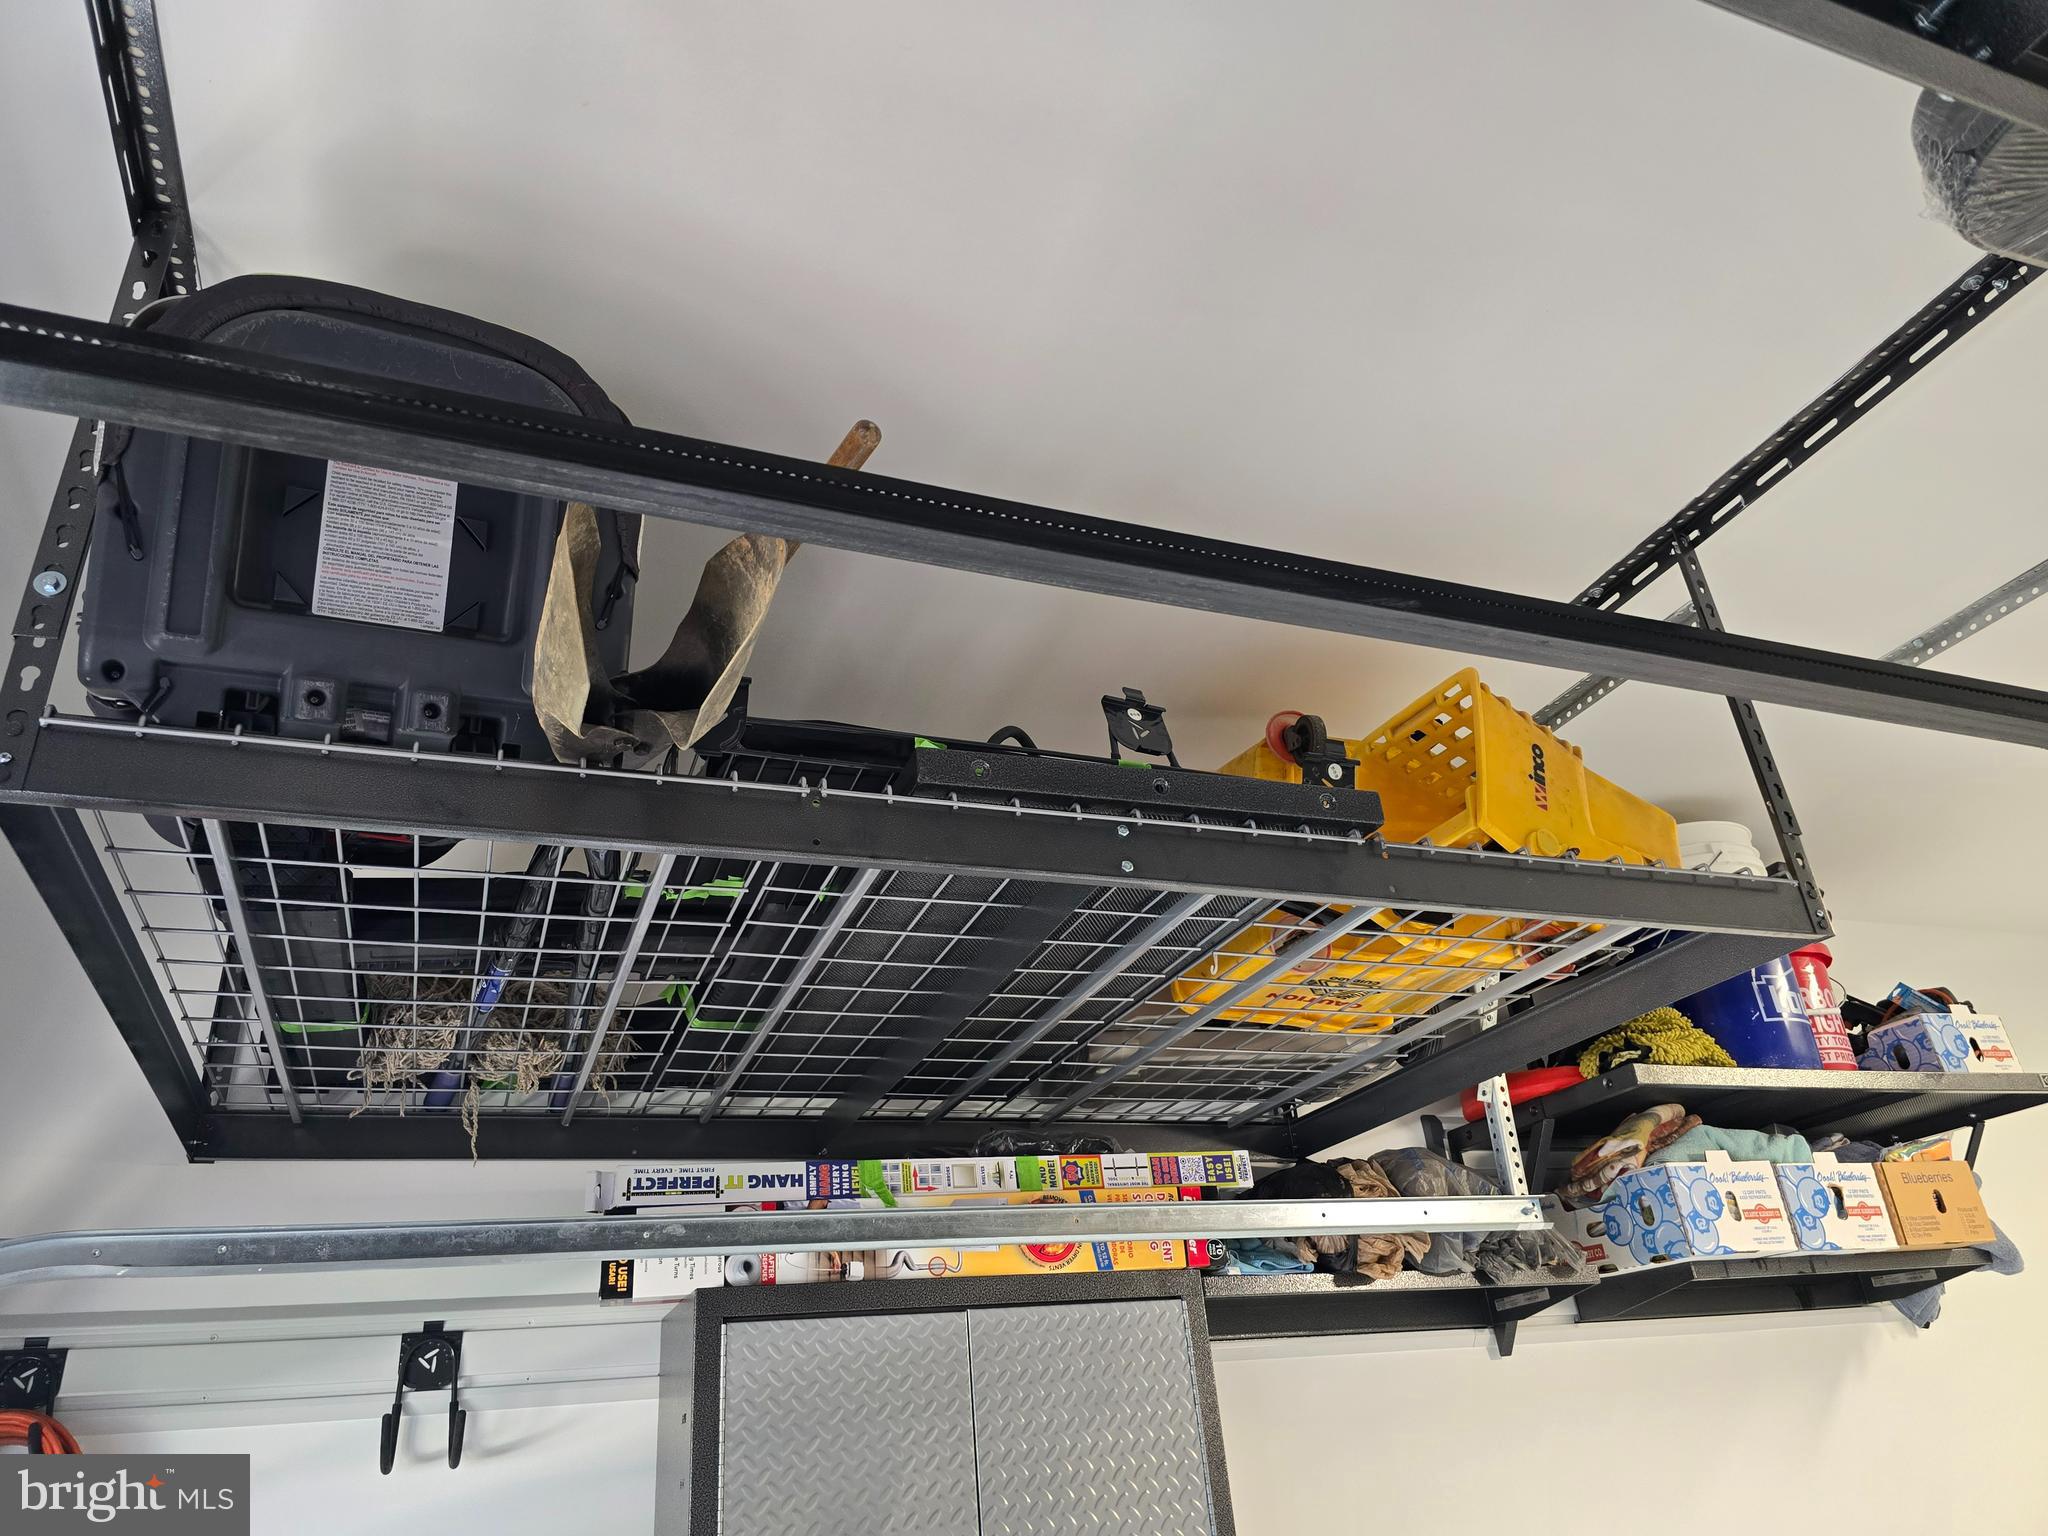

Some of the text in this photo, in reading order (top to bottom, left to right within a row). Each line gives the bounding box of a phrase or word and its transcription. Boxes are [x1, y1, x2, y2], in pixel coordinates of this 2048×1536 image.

[818, 1163, 830, 1196] HANG
[832, 1164, 841, 1195] EVERY
[842, 1163, 850, 1195] THING
[1039, 1166, 1047, 1185] AND
[1047, 1159, 1058, 1188] MORE!
[1204, 1156, 1216, 1182] EASY
[1215, 1163, 1223, 1175] TO
[1223, 1157, 1232, 1180] USE!
[1900, 1171, 1954, 1184] Blueberries
[632, 1176, 715, 1190] PERFECT
[724, 1174, 803, 1189] HANG IT
[809, 1165, 817, 1196] SIMPLY
[1162, 1240, 1173, 1263] ENT
[1216, 1243, 1223, 1255] 10
[608, 1262, 616, 1286] USAR!
[617, 1266, 627, 1292] USE!
[1049, 1263, 1065, 1272] VENTS
